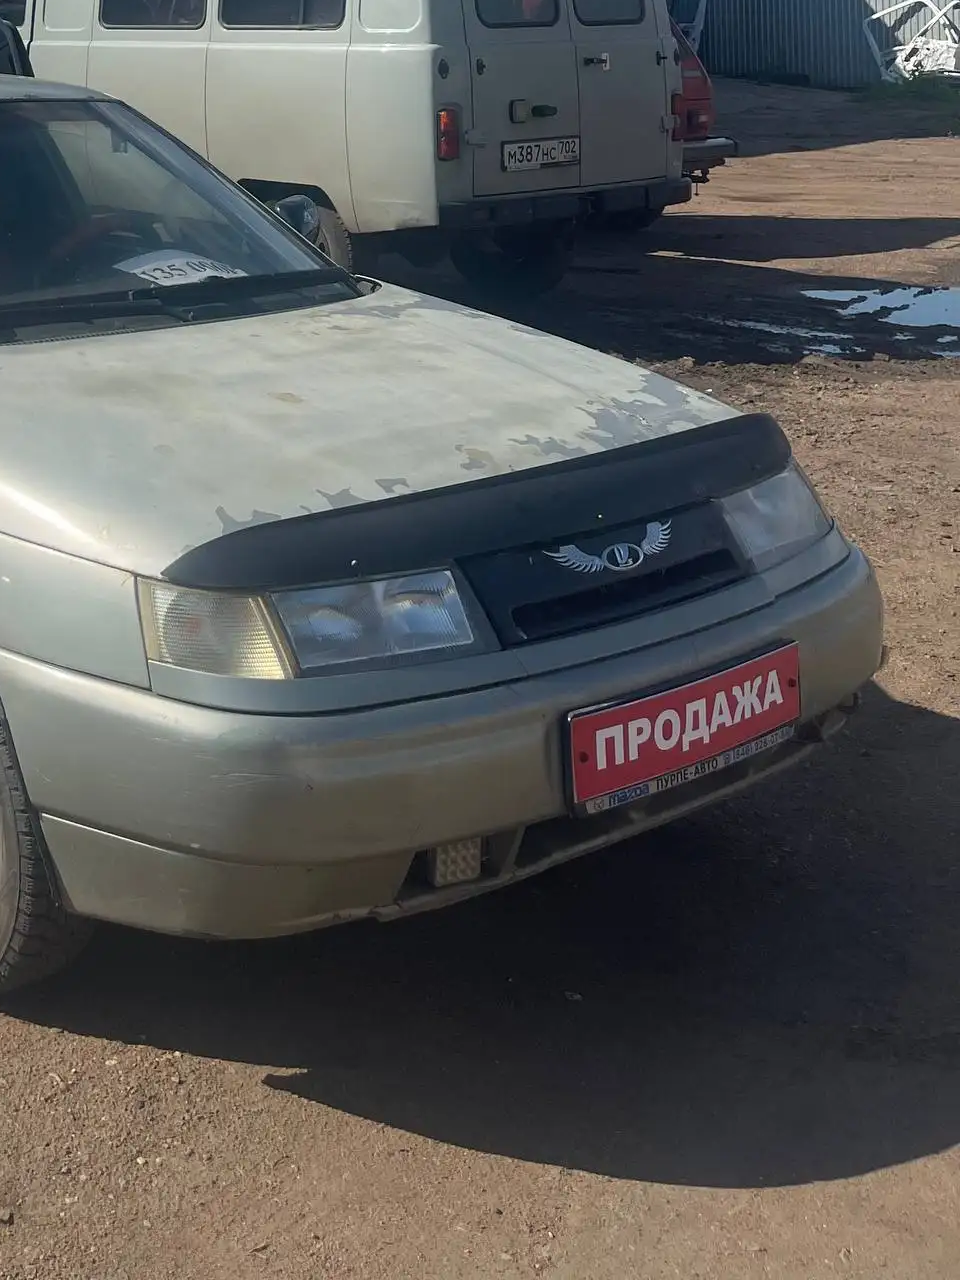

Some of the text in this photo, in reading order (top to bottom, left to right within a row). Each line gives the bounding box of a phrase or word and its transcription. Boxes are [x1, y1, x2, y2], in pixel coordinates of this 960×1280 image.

[507, 140, 576, 165] М387НС 702
[140, 263, 188, 281] 135
[594, 669, 784, 771] ПРОДАЖА
[655, 757, 719, 791] ПУРПЕ-АВТО
